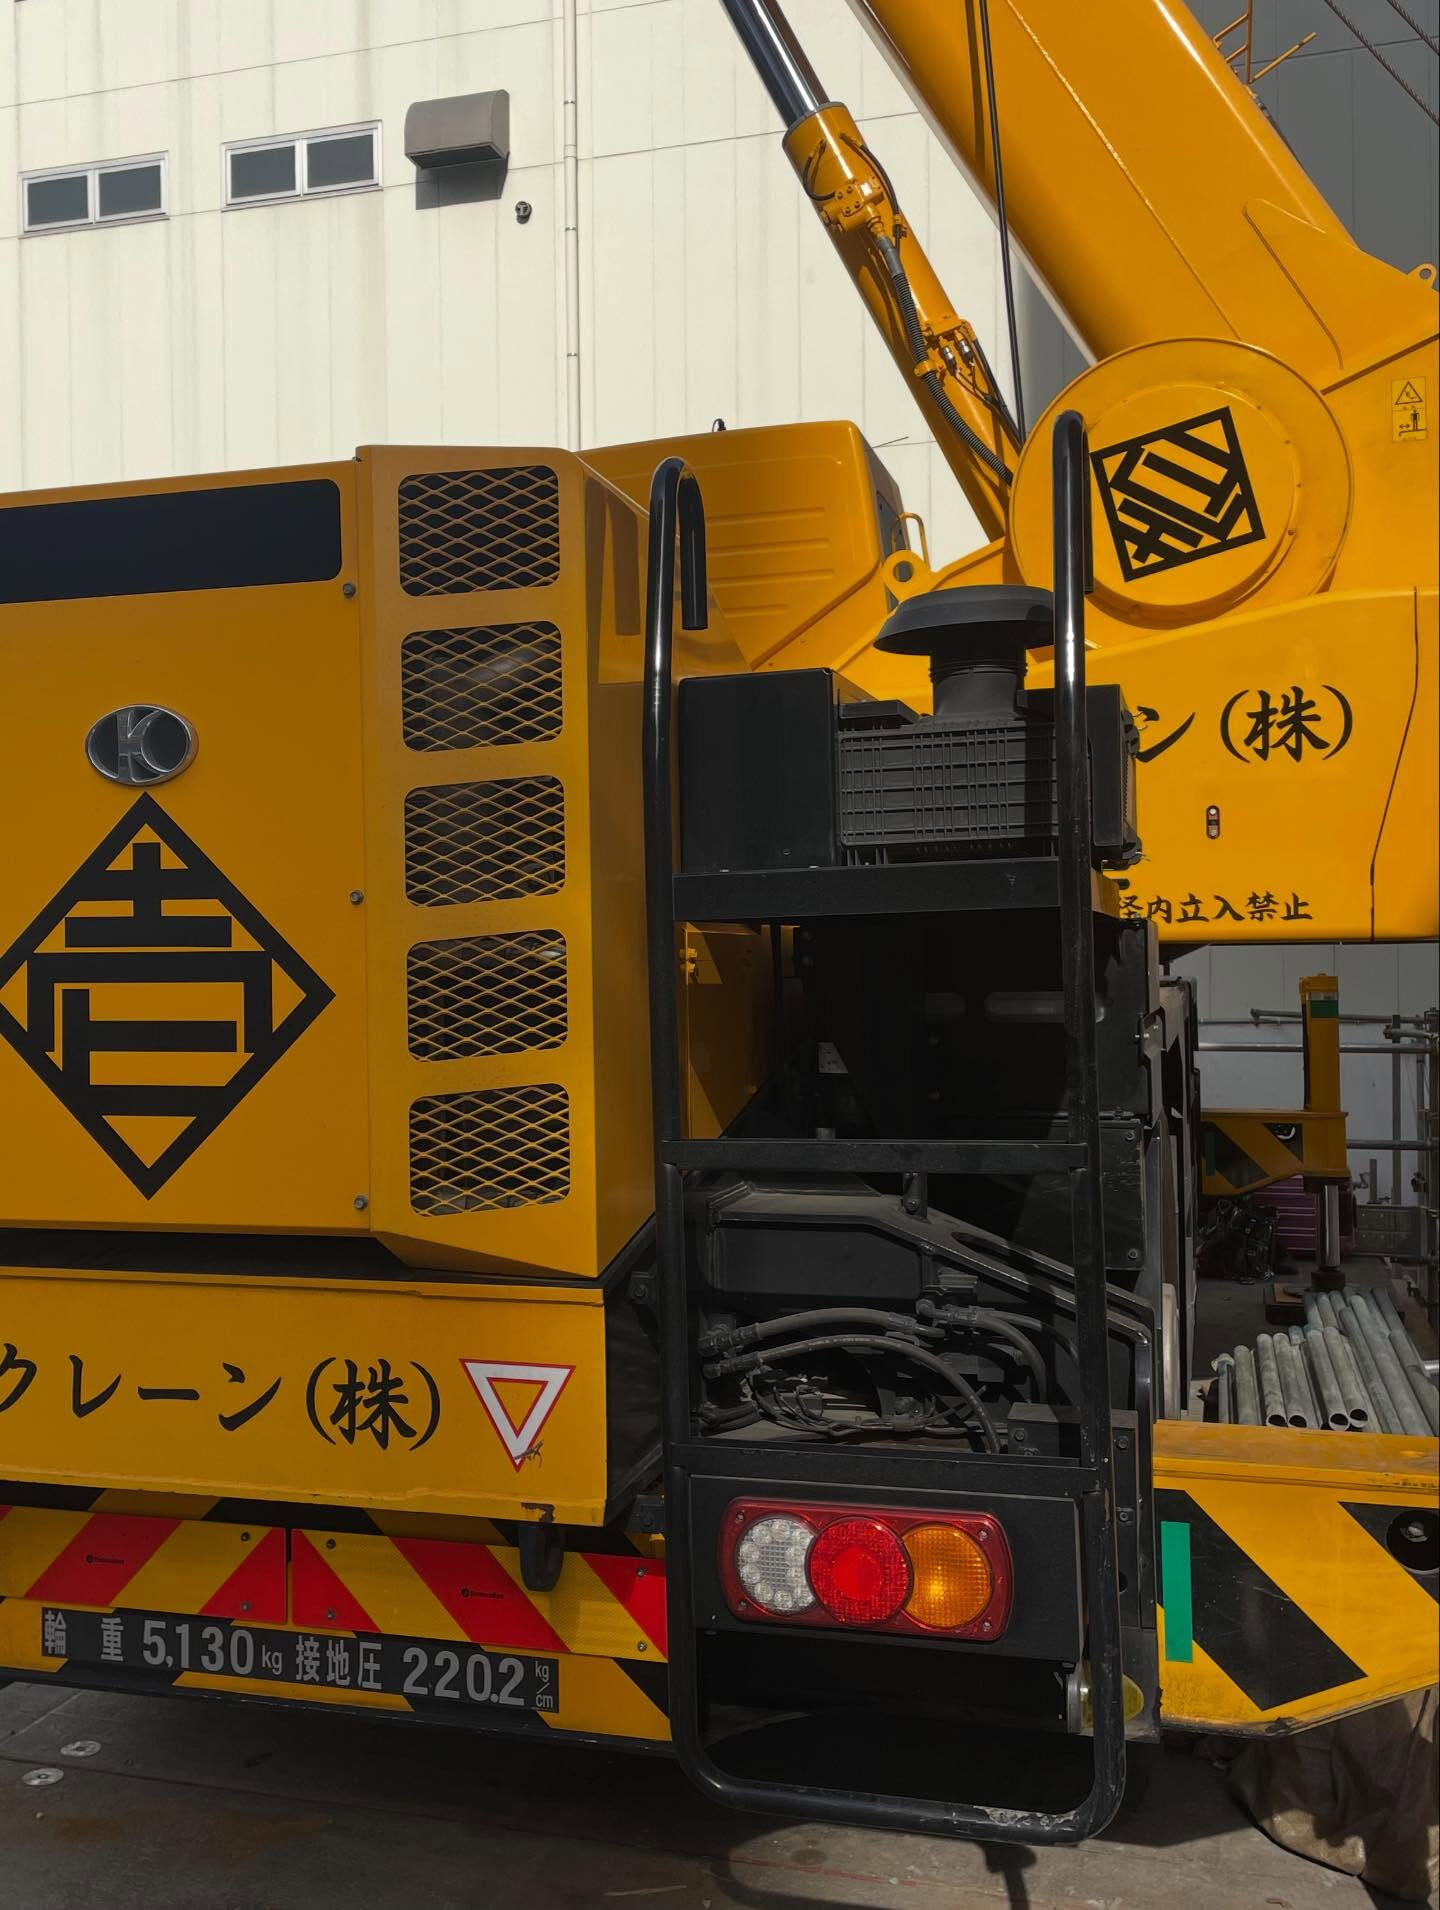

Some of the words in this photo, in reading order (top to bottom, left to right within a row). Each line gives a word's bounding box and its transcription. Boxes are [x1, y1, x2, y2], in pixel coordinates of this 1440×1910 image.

[142, 1619, 255, 1675] 5,130
[261, 1644, 283, 1675] kg
[295, 1635, 382, 1690] 接地圧
[402, 1647, 526, 1706] 220.2
